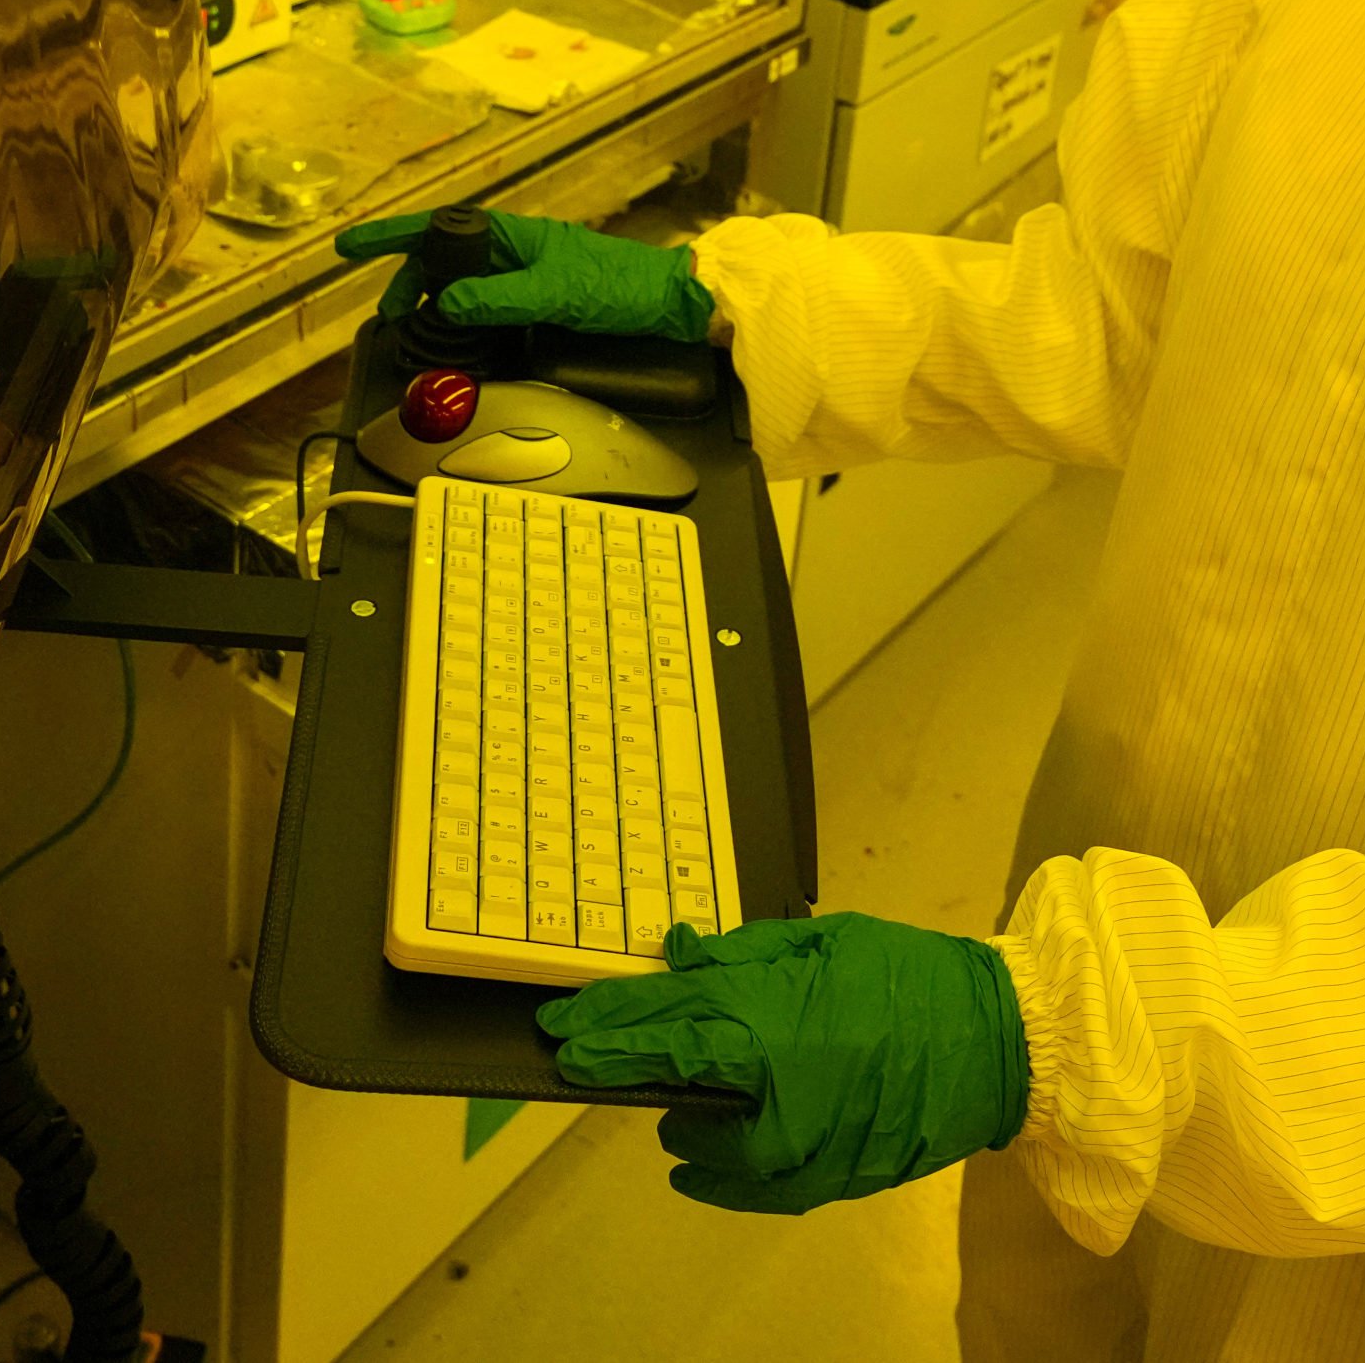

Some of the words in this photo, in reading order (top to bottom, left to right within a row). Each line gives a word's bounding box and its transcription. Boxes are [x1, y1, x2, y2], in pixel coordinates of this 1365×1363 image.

[575, 654, 588, 662] K
[618, 674, 631, 682] M
[619, 704, 632, 712] N
[577, 713, 590, 721] H
[621, 735, 634, 743] B
[578, 744, 591, 752] G
[534, 778, 548, 786] R
[534, 811, 548, 819] E
[580, 809, 594, 817] D
[627, 831, 641, 839] X
[535, 840, 549, 852] W
[581, 843, 595, 851] S
[629, 867, 643, 875] Z
[536, 880, 549, 889] Q
[583, 878, 597, 886] A
